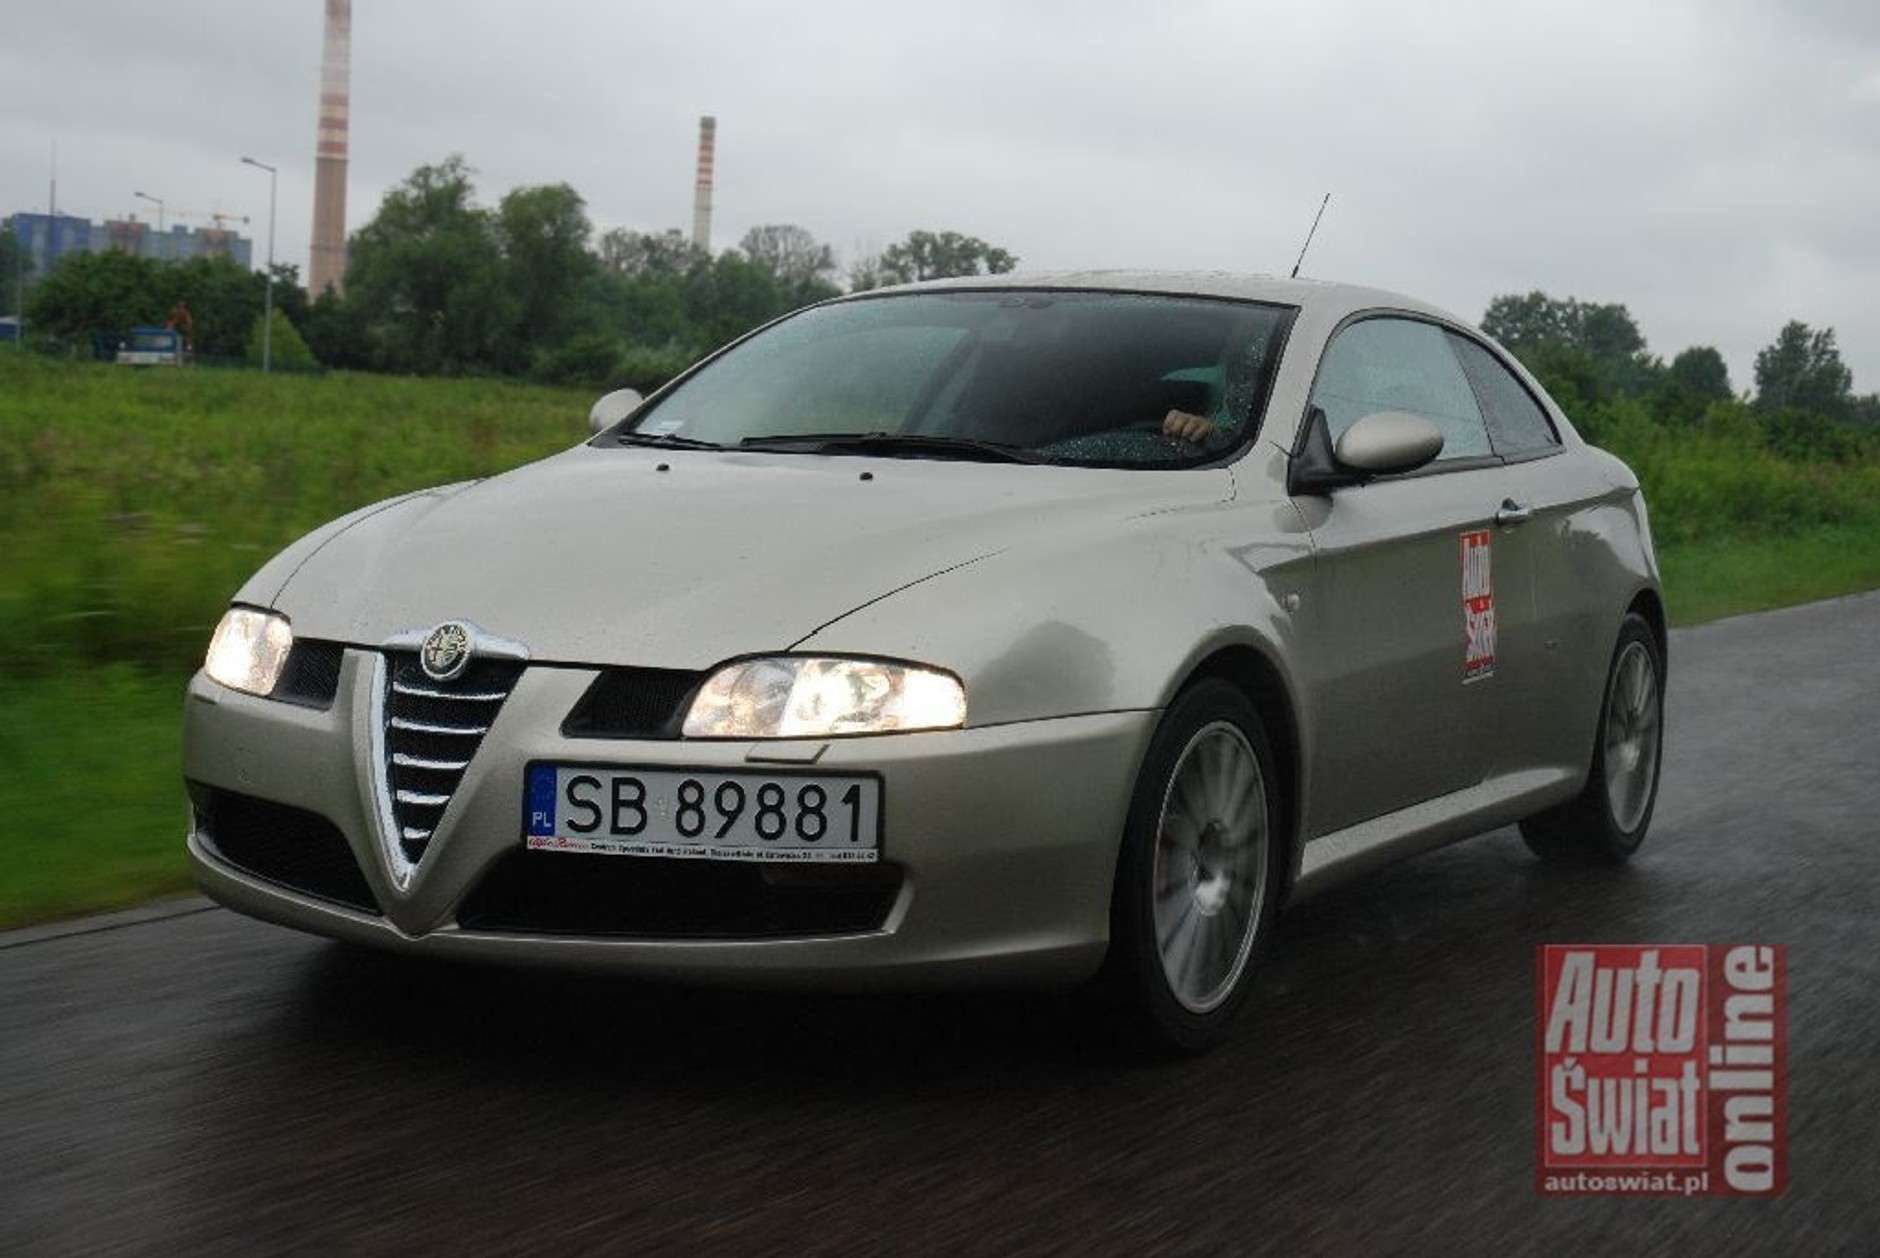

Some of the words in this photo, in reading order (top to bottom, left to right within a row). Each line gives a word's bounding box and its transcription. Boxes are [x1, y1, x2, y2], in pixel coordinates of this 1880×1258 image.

[532, 810, 552, 828] PL
[565, 775, 648, 836] SB
[675, 778, 861, 843] 89881
